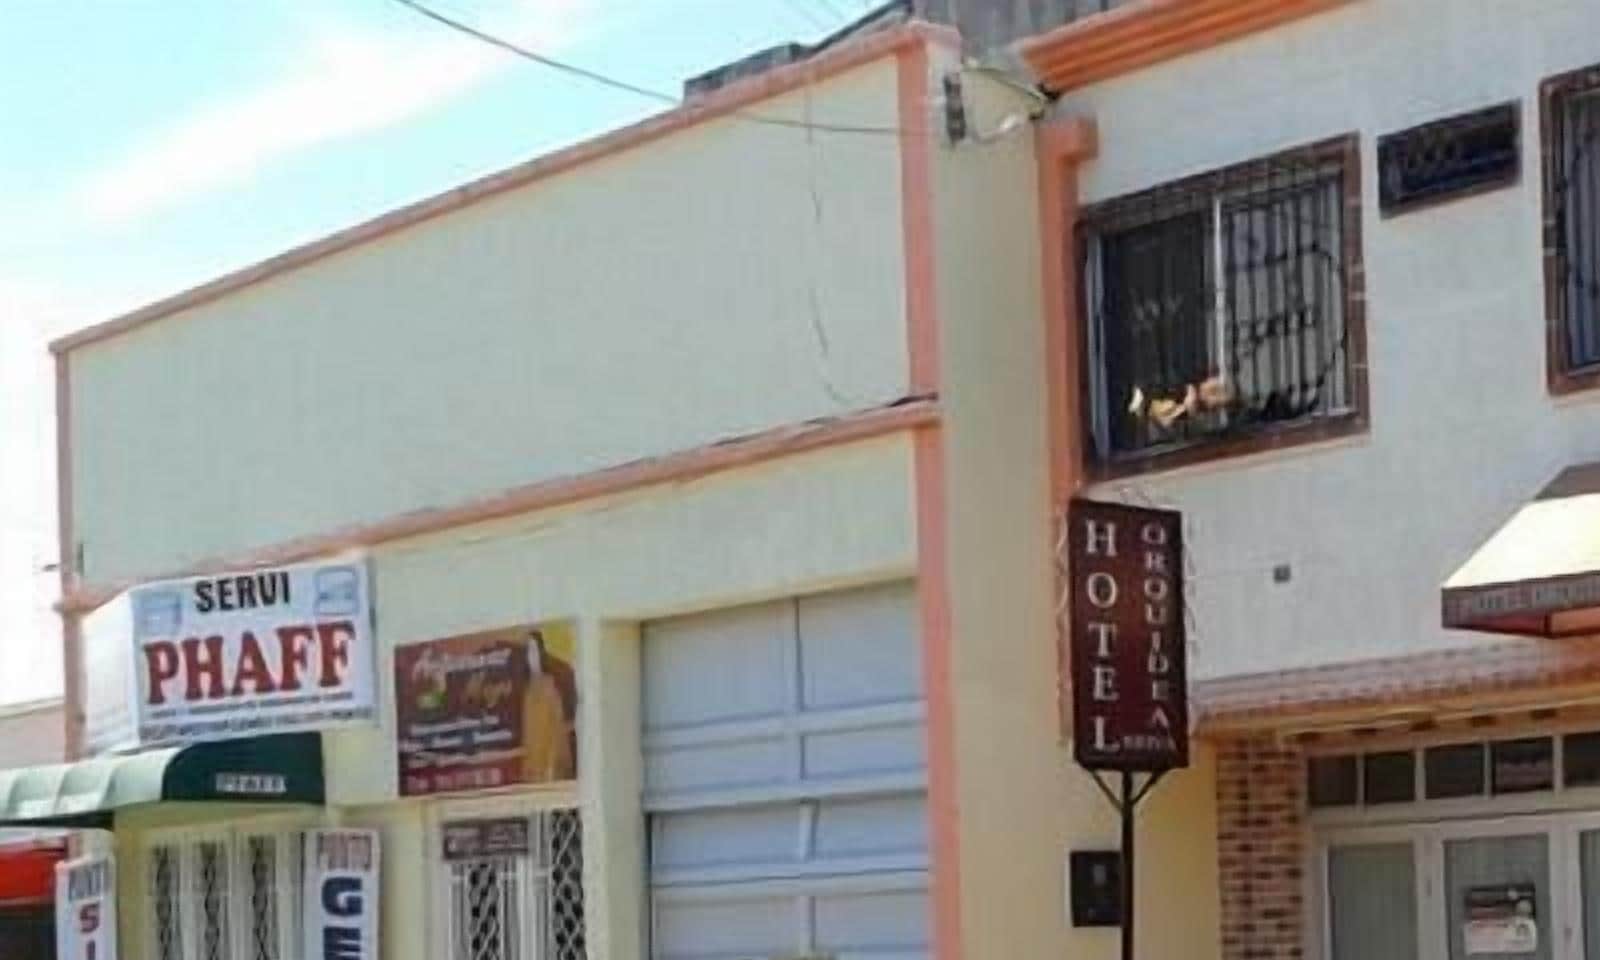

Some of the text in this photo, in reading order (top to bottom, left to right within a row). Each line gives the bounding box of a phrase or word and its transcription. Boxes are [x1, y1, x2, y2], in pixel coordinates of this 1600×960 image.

[143, 619, 356, 705] PHAFF
[194, 570, 291, 614] SERVI
[1086, 519, 1121, 752] HOTEL
[1141, 521, 1171, 730] ORQUIDEA
